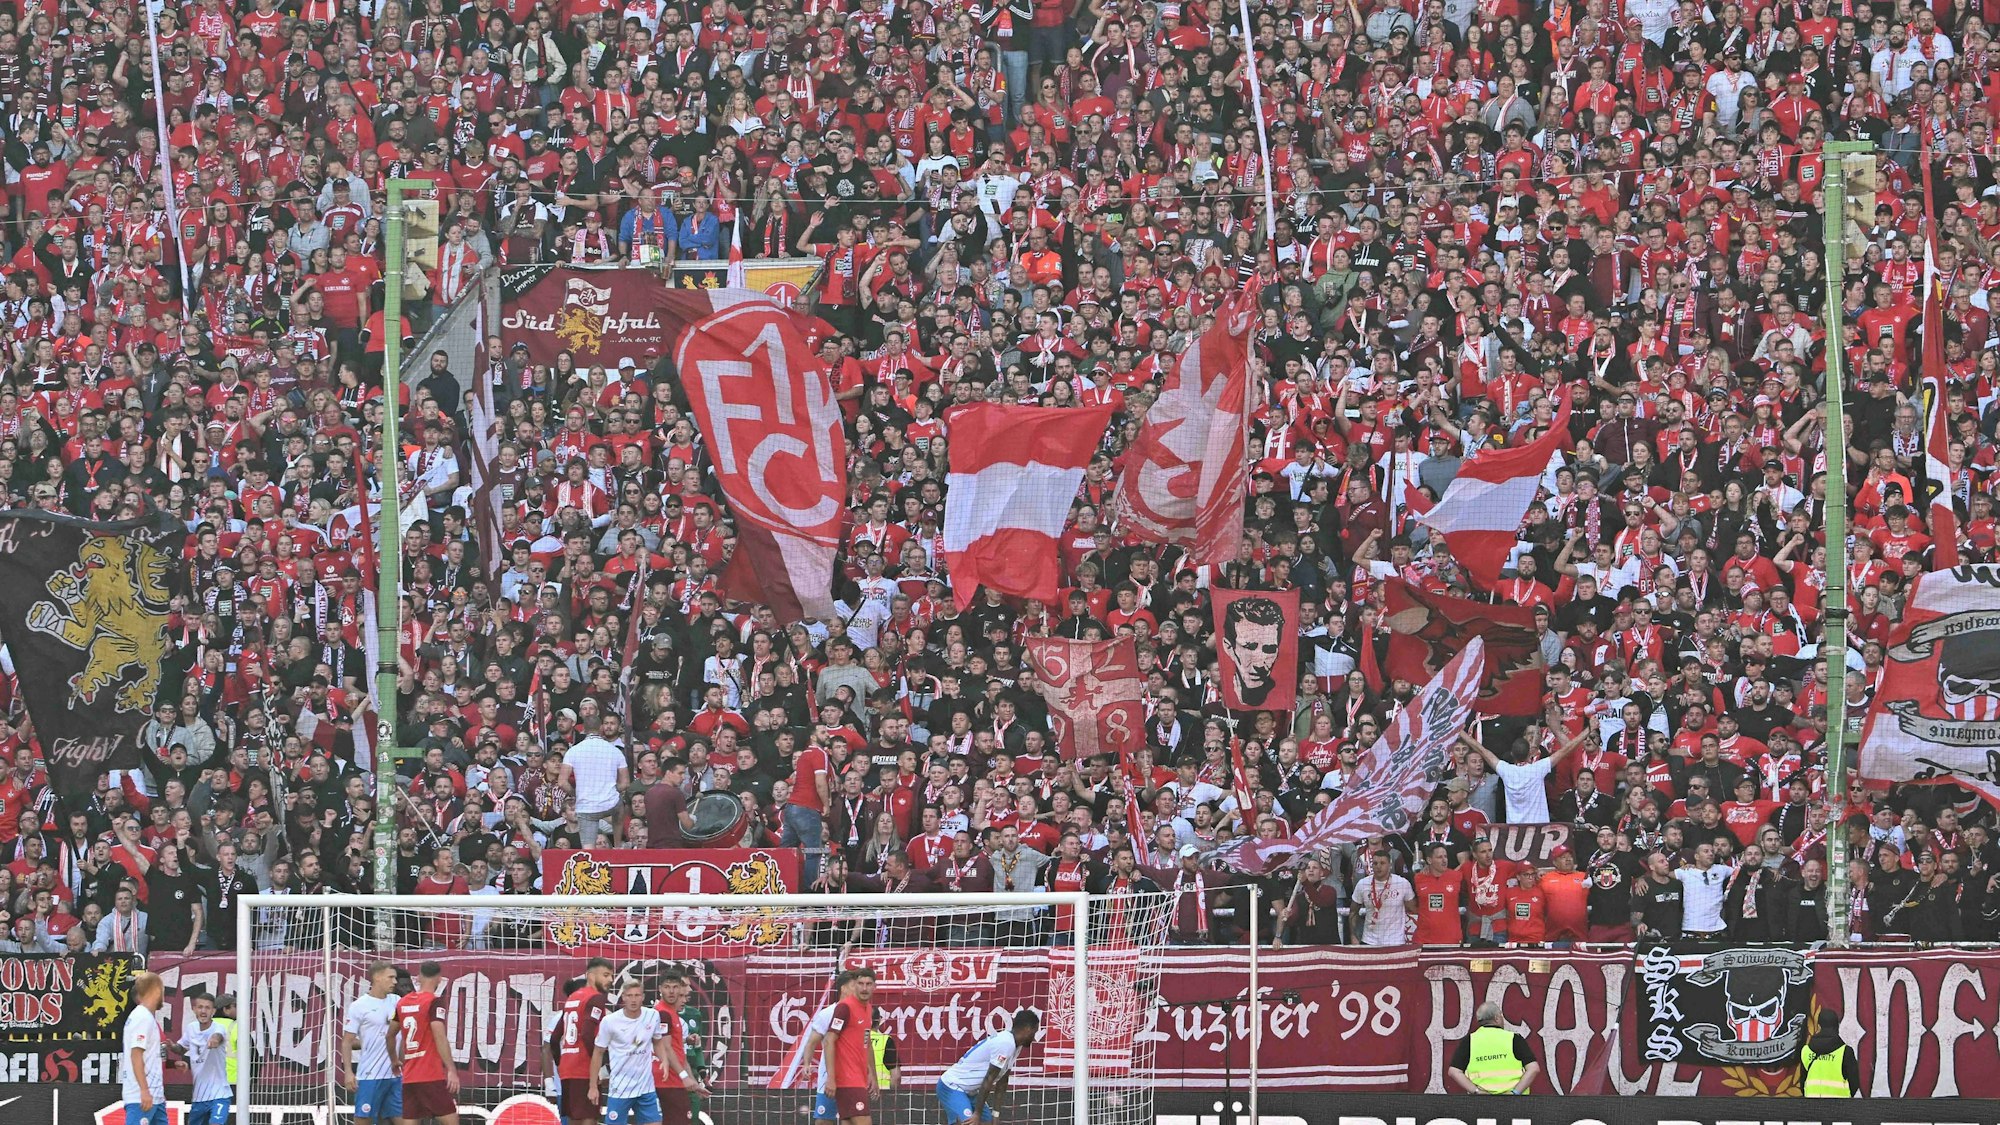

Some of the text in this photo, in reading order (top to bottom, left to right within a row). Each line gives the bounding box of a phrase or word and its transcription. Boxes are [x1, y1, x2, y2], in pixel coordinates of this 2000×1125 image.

[1355, 257, 1380, 267] LAUTRE
[502, 309, 661, 334] Süd pfal
[1105, 708, 1132, 744] 8
[0, 957, 75, 991] OWN
[951, 955, 995, 981] SV
[403, 1016, 419, 1050] 2
[562, 1010, 579, 1045] 16
[1838, 962, 2000, 1098] INF
[1475, 1053, 1508, 1063] SECURITY
[1725, 1040, 1786, 1059] Kompanie
[1808, 1053, 1836, 1063] SEURITY
[216, 1103, 224, 1115] 7
